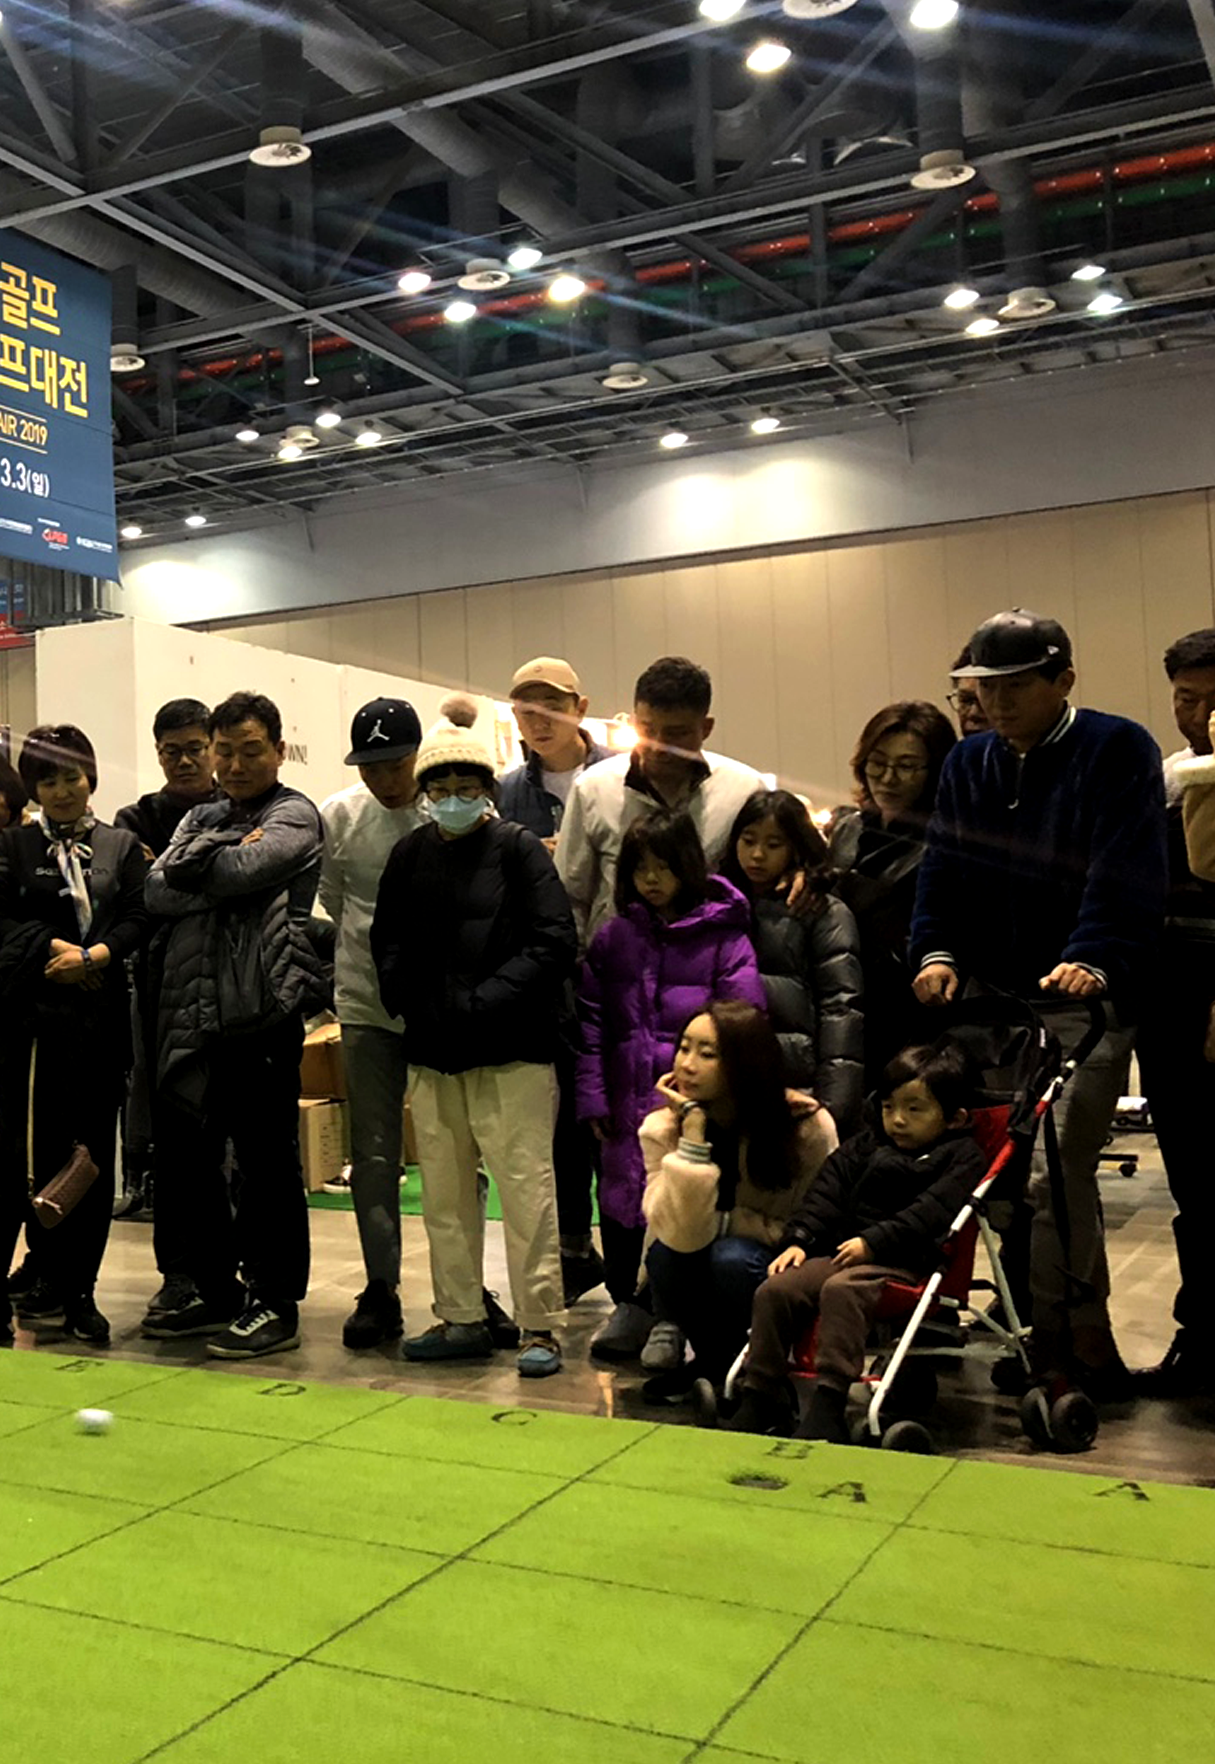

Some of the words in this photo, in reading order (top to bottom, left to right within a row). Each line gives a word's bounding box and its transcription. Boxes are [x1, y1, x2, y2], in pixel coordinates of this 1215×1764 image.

[20, 419, 48, 446] 2019
[0, 457, 50, 498] 3.3(일)
[816, 1480, 868, 1503] A
[1093, 1481, 1151, 1502] A
